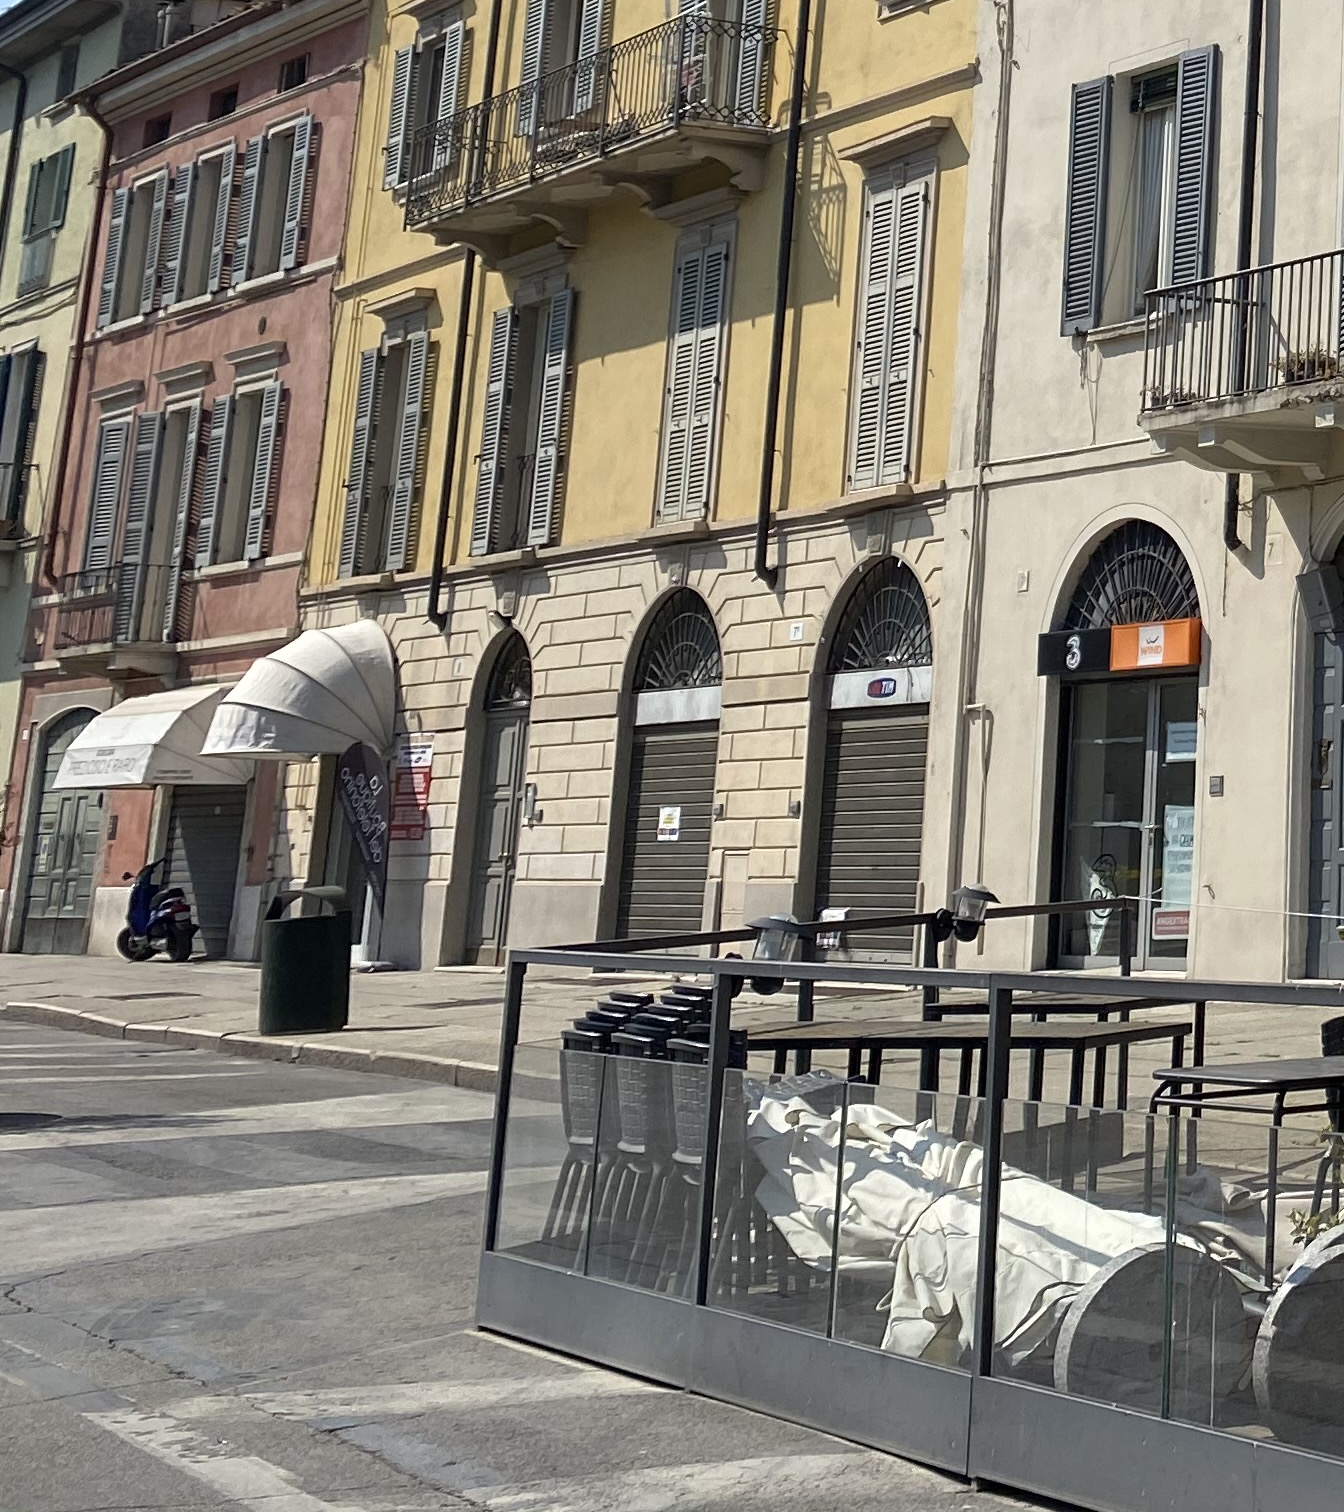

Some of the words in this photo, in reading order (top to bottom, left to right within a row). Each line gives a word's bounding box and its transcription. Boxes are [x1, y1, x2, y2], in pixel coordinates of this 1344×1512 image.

[1268, 542, 1275, 558] 7
[1065, 634, 1082, 671] 3
[1140, 645, 1163, 656] WIND
